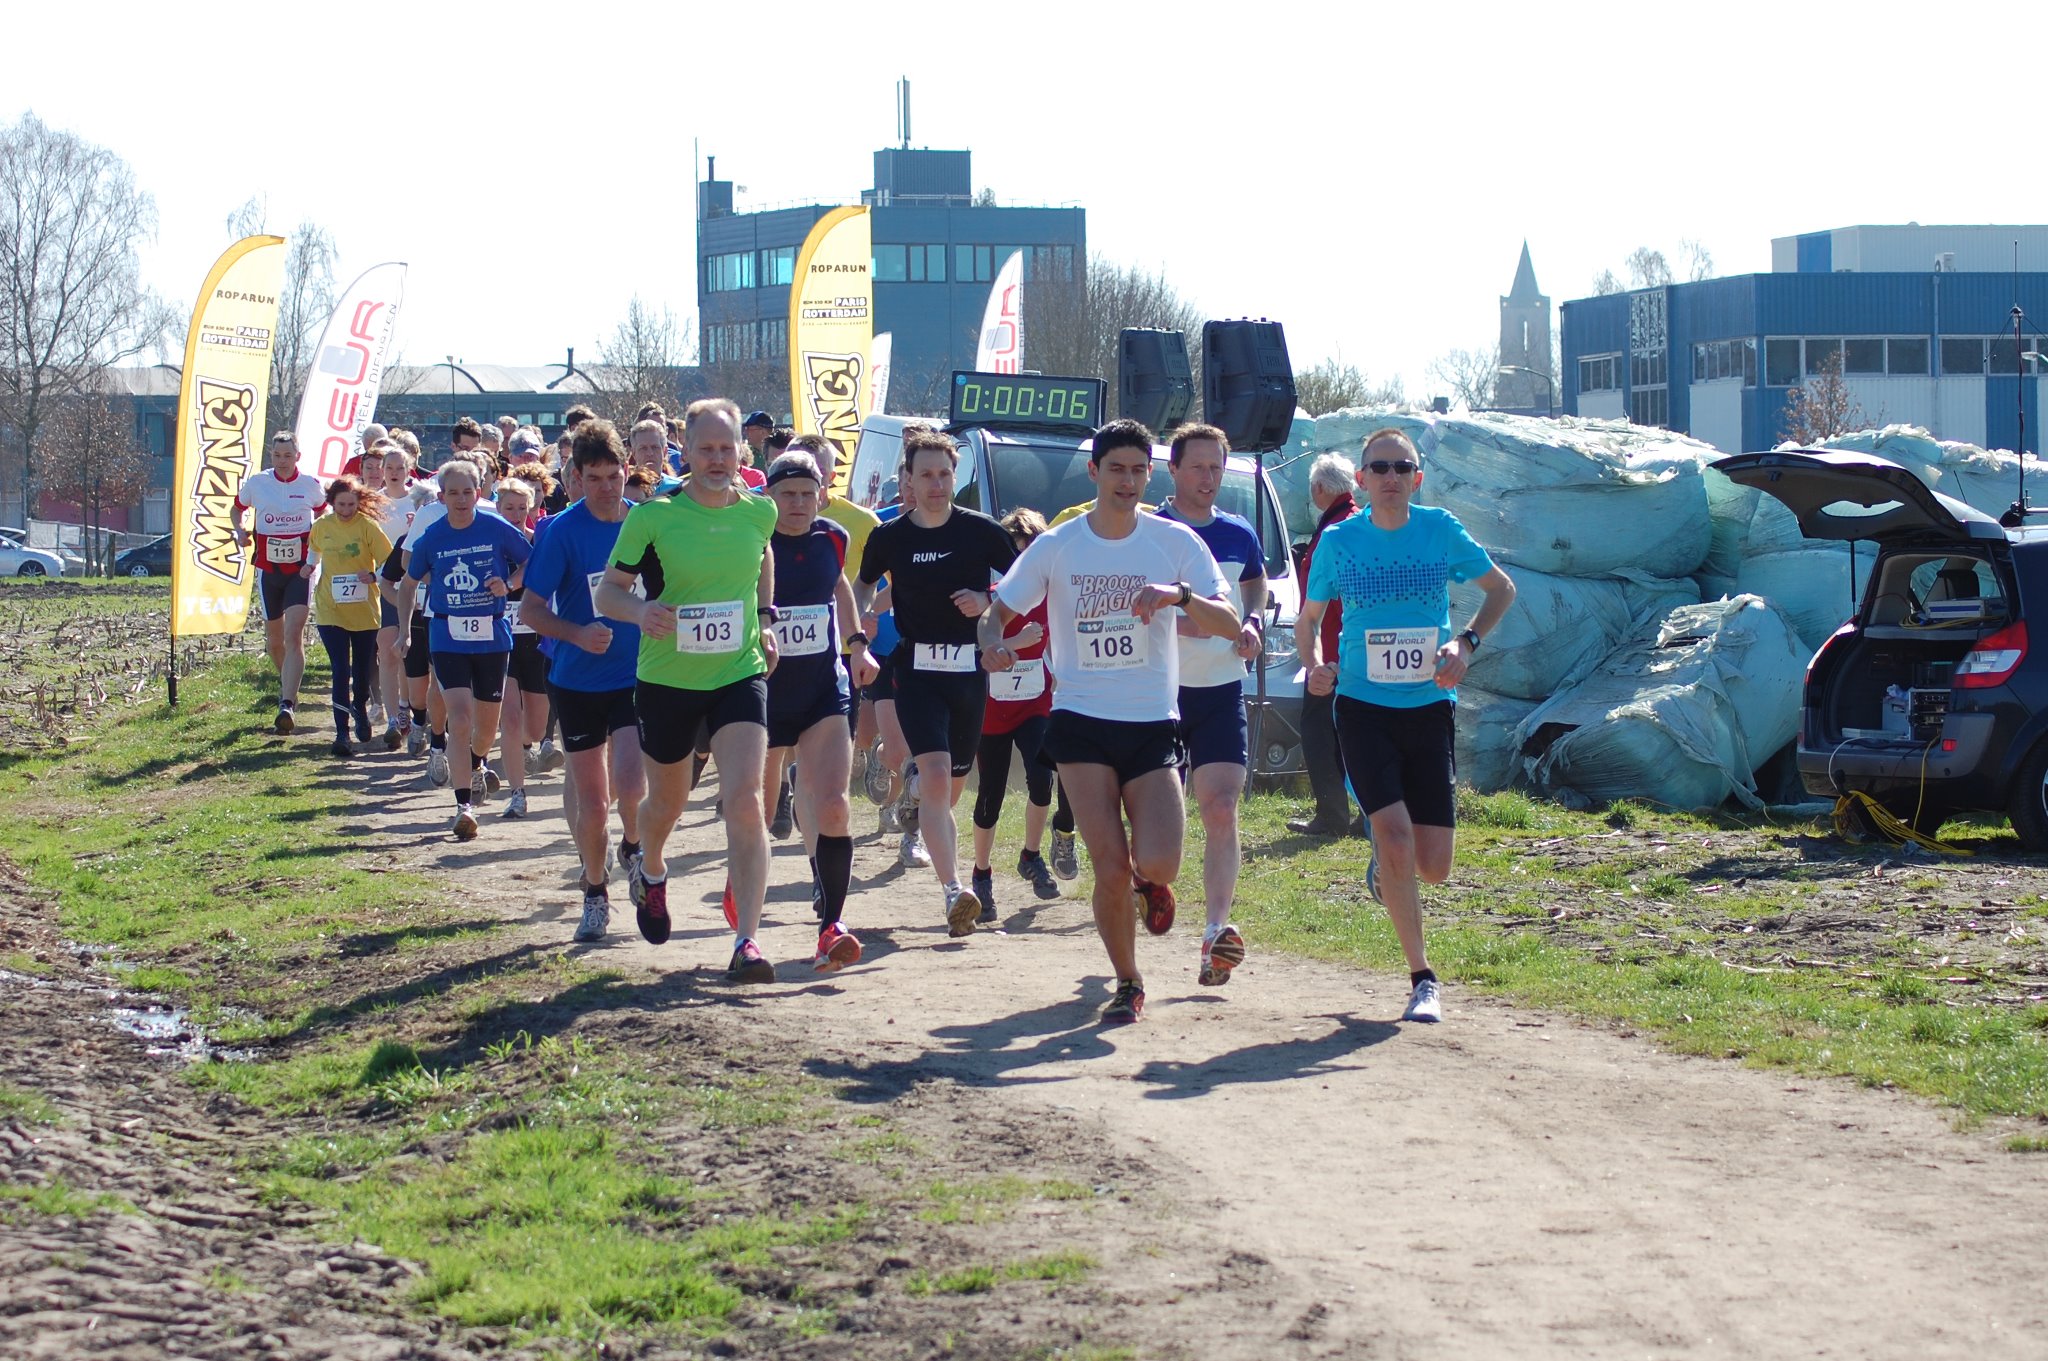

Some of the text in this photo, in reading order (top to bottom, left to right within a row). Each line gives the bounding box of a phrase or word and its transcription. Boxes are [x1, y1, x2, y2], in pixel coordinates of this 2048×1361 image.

[811, 264, 866, 273] ROPARUN
[216, 290, 275, 305] ROPARUN
[835, 297, 867, 307] PARIS
[803, 308, 867, 318] ROTTERDAM
[237, 326, 270, 339] PARIS
[202, 333, 268, 350] ROTTERDAM
[961, 384, 1089, 419] 0:00:06
[195, 380, 254, 580] AMAZING!
[275, 515, 303, 523] VEOLIA
[274, 547, 294, 558] 113
[912, 552, 937, 563] RUN
[342, 585, 357, 596] 27
[1071, 574, 1147, 597] IS BROOKS
[706, 611, 734, 619] WORLD
[462, 619, 479, 633] 18
[692, 621, 731, 642] 103
[1104, 624, 1134, 633] WORLD
[778, 623, 817, 644] 104
[928, 643, 963, 661] 117
[1089, 635, 1134, 658] 108
[1382, 648, 1423, 670] 109
[1012, 675, 1022, 691] 7
